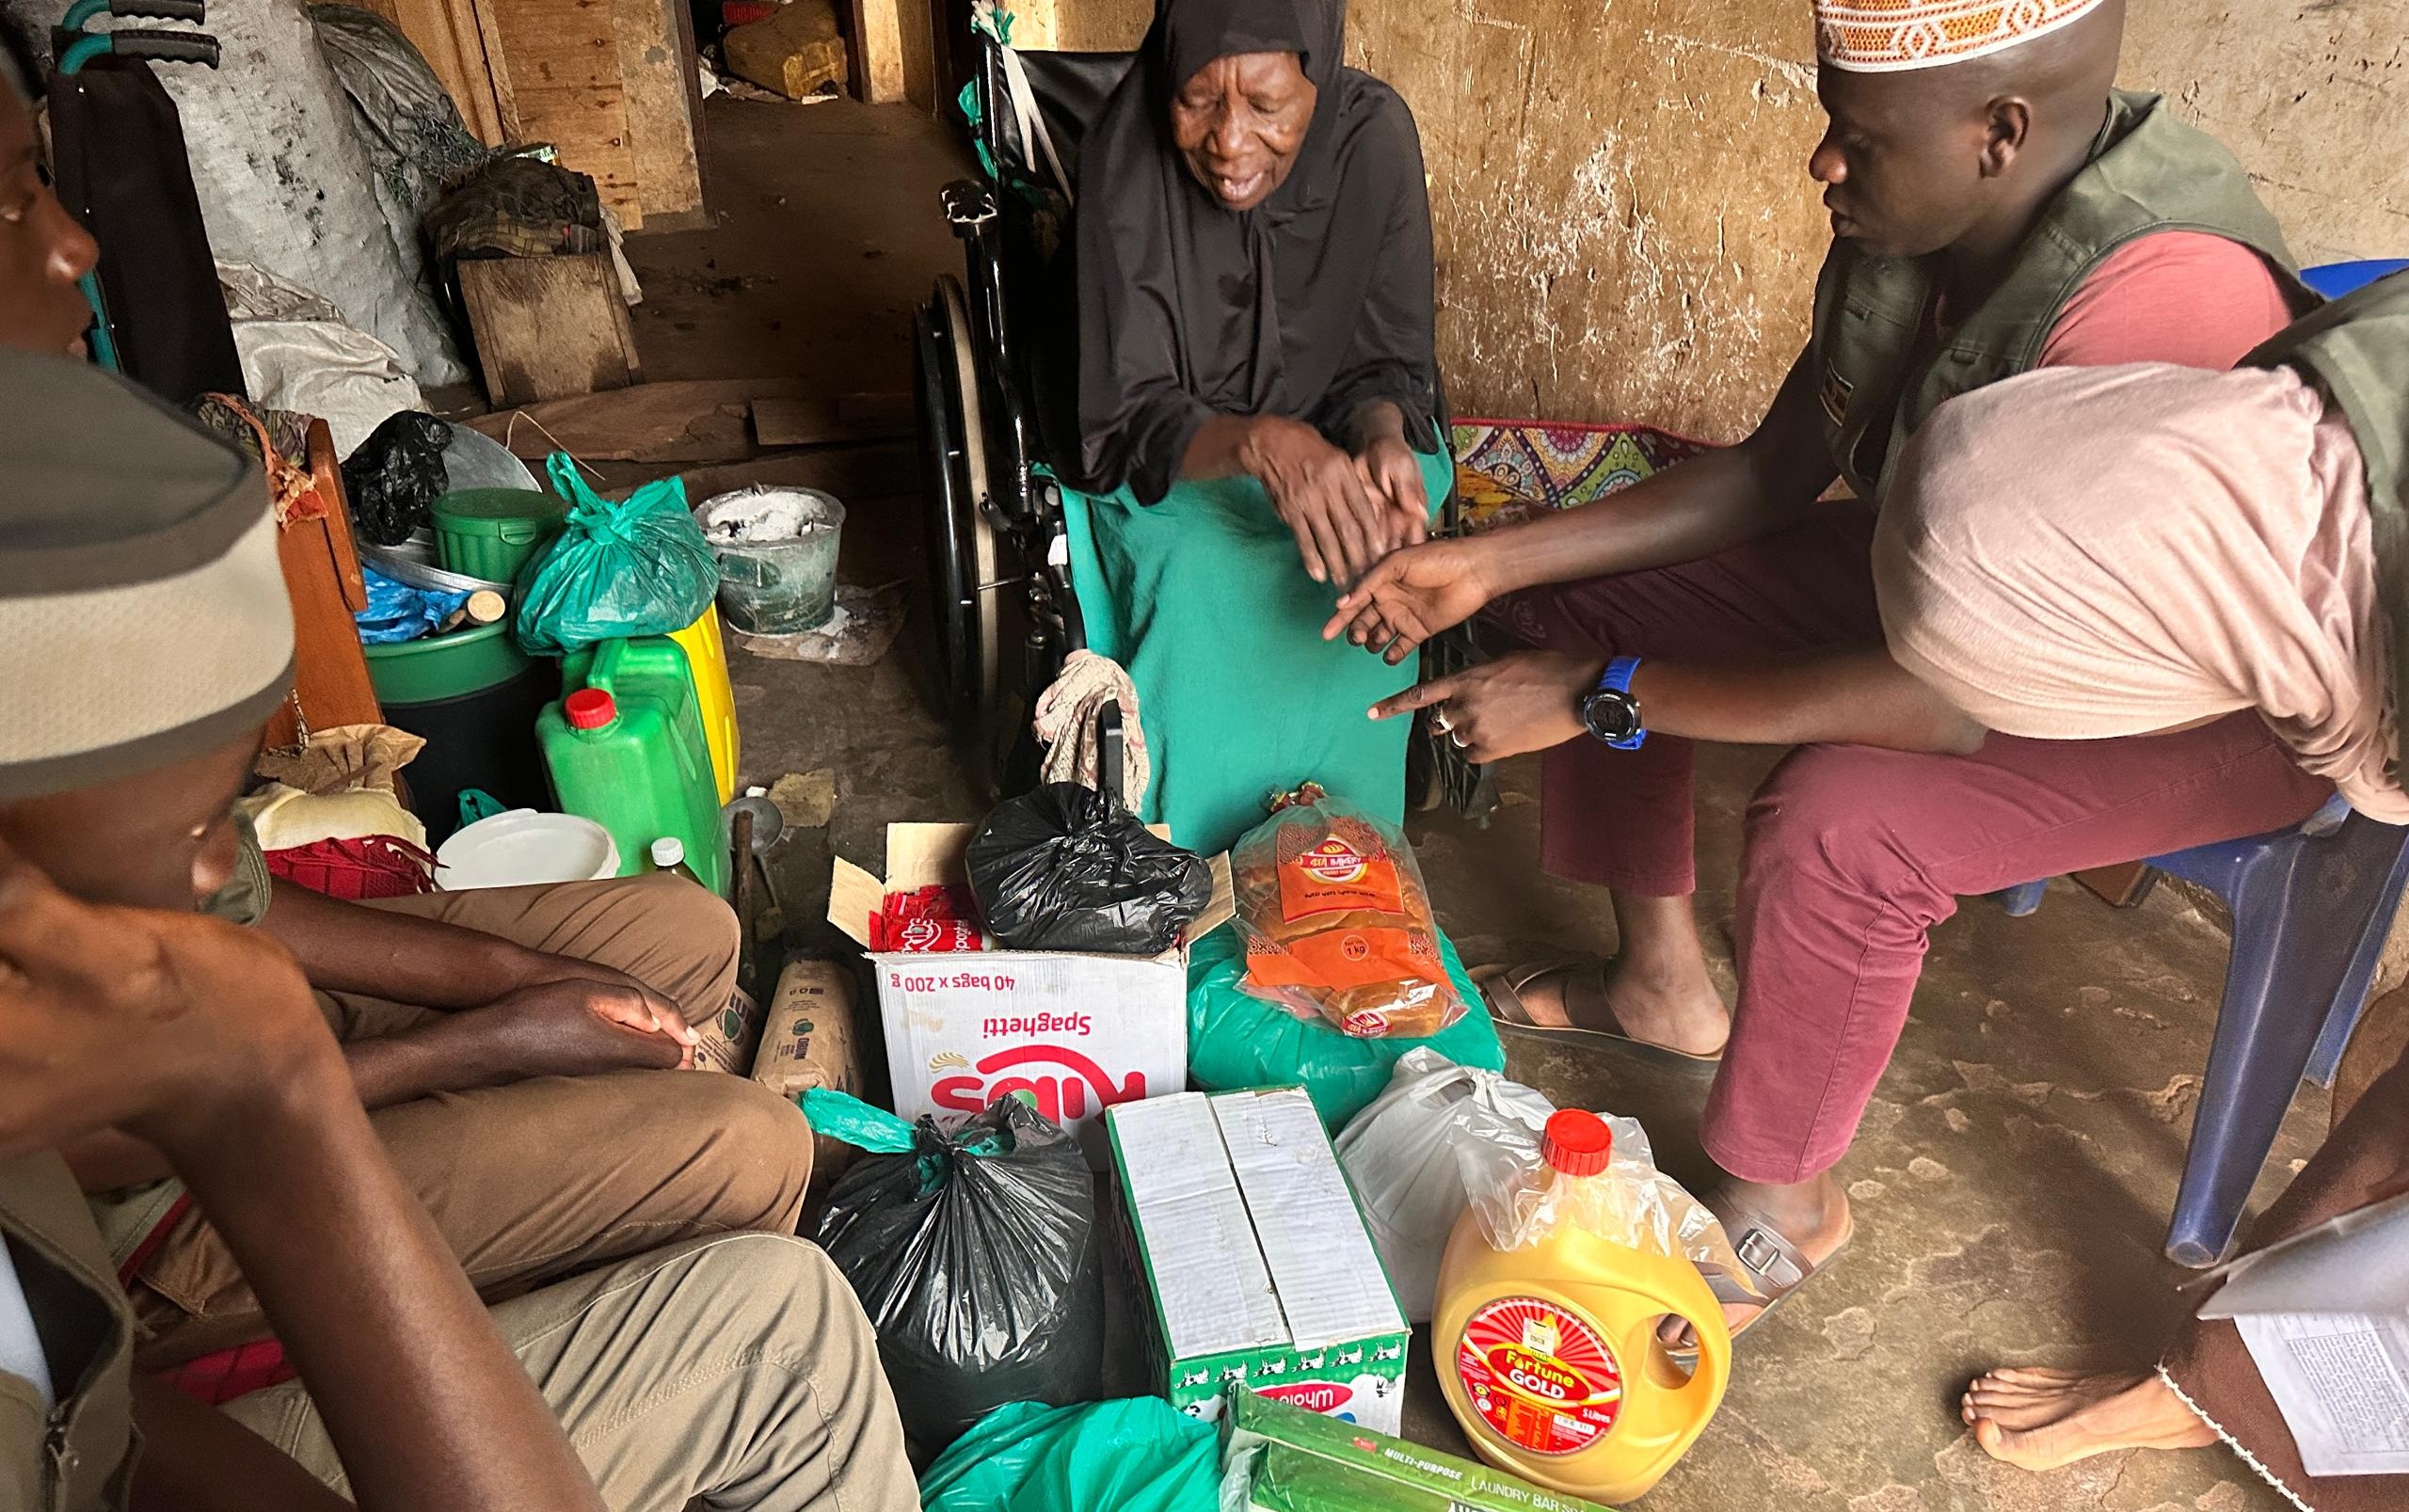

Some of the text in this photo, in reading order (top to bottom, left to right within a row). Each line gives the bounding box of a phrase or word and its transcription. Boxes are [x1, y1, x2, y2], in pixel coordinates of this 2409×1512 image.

[1354, 946, 1365, 954] kg
[890, 973, 1015, 992] 40 bags x 200 g
[982, 1011, 1092, 1039] Spaghetti
[1506, 1350, 1575, 1389] Fortune
[1508, 1368, 1566, 1400] GOLD
[1588, 1409, 1611, 1424] Litres
[1384, 1447, 1559, 1512] MULTI-PURPOSE LAUNDRY BAR
